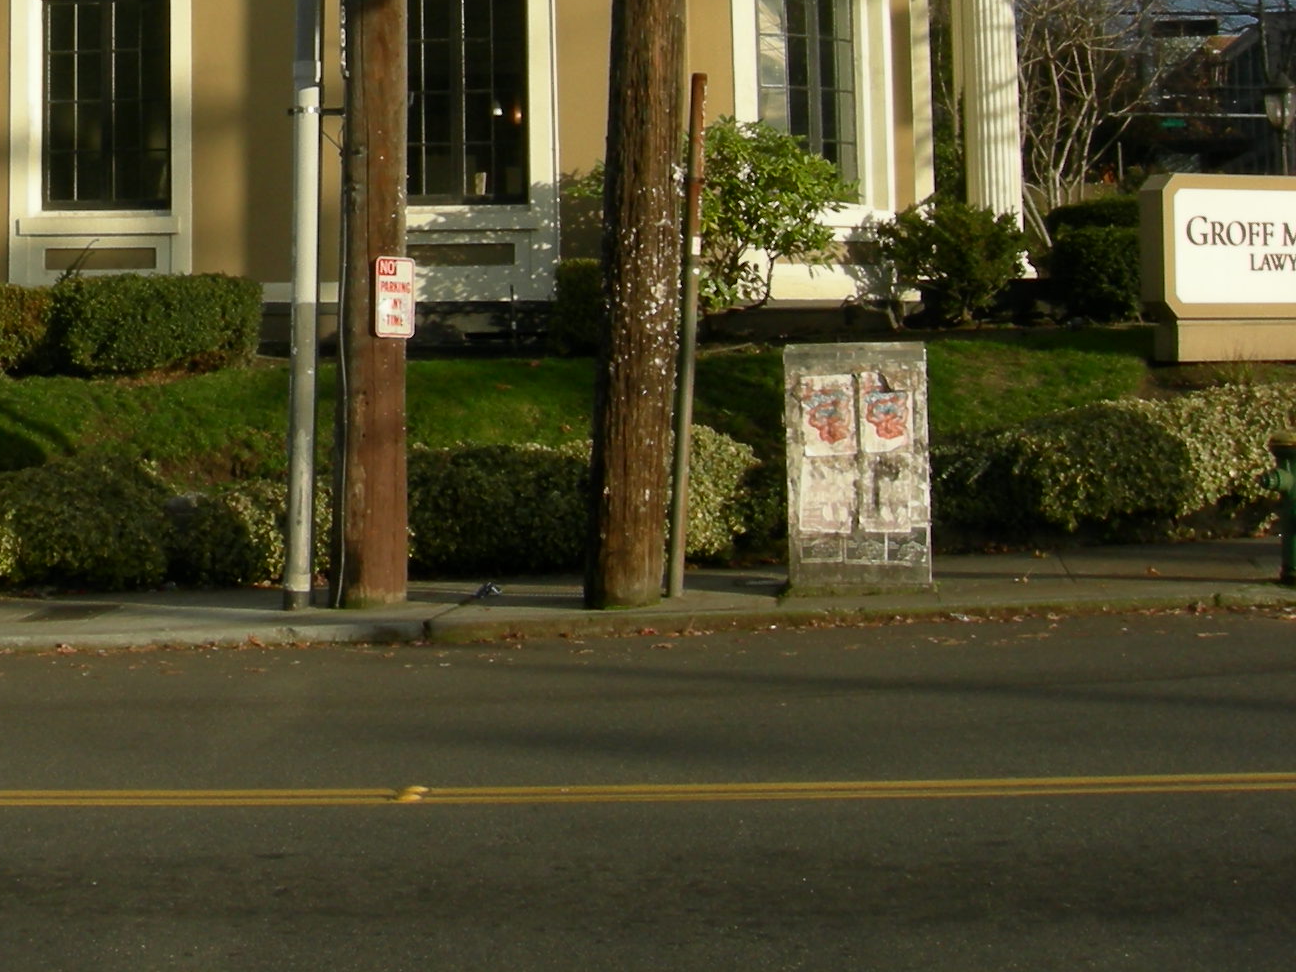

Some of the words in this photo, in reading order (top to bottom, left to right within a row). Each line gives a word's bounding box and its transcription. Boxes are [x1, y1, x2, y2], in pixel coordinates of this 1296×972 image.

[1186, 215, 1275, 246] GROFF
[379, 259, 395, 275] NO
[1250, 253, 1296, 271] LAWY
[380, 281, 411, 294] PARKING
[387, 298, 402, 309] NY
